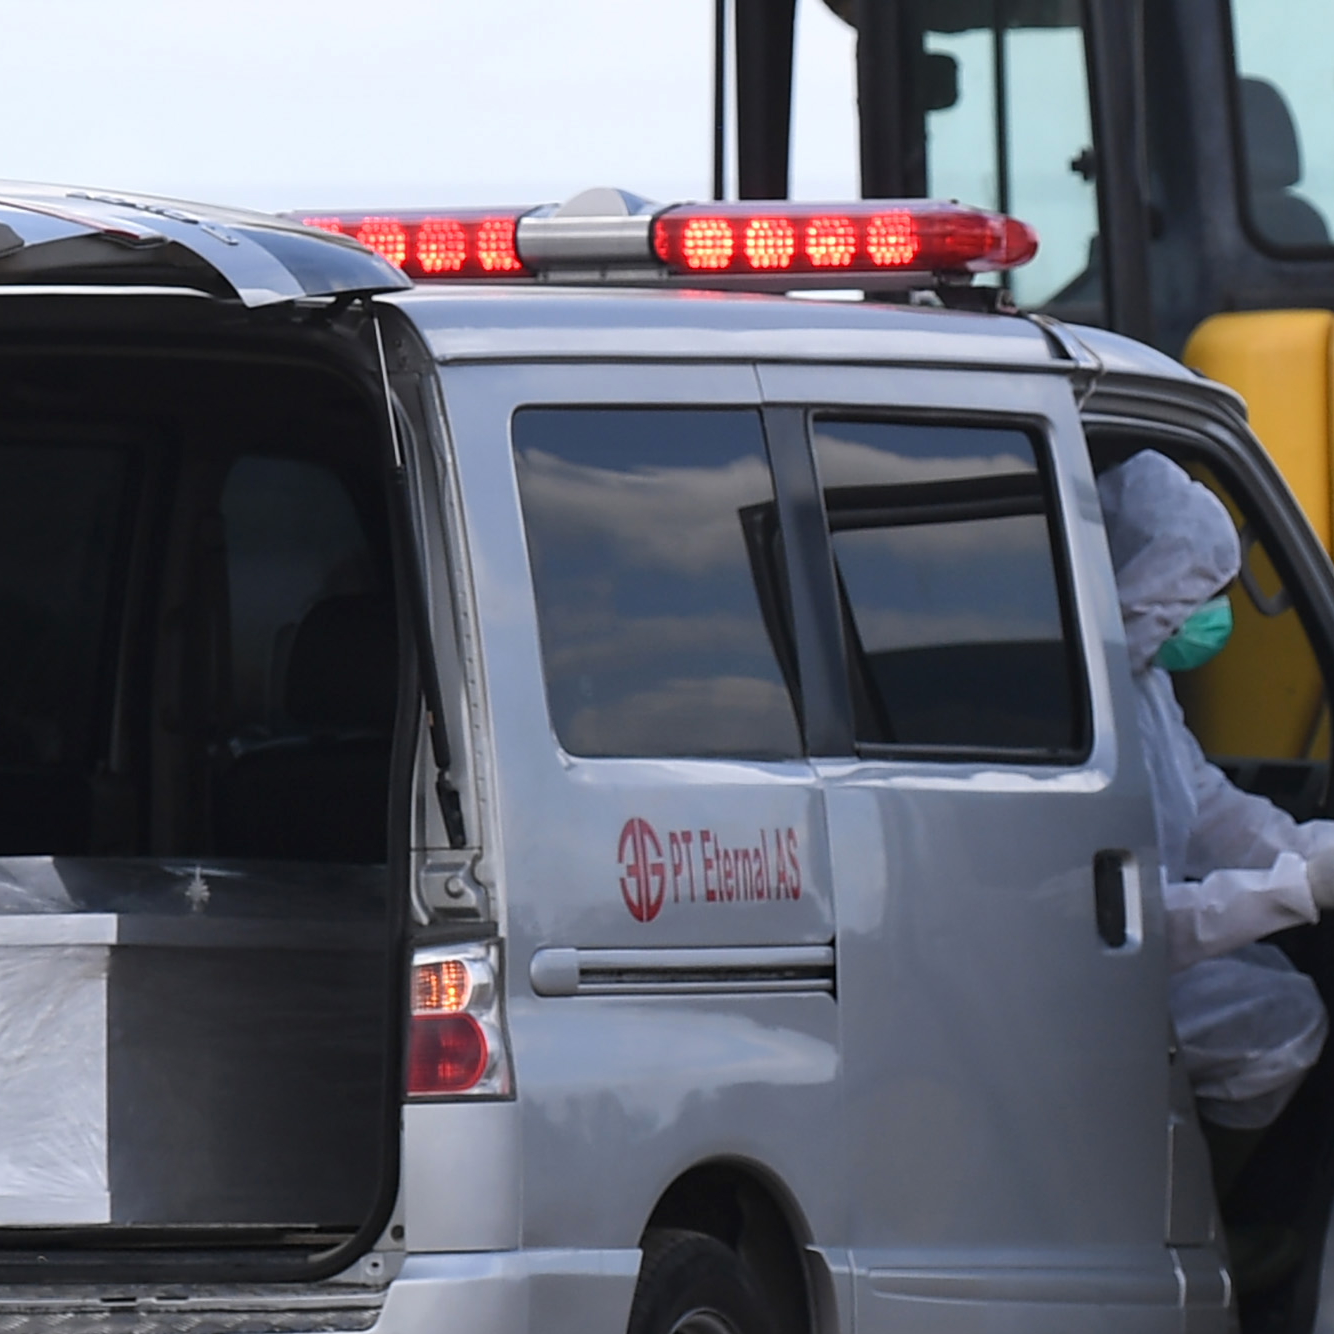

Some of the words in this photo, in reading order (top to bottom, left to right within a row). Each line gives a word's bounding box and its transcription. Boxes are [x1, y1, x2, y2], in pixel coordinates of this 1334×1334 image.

[669, 830, 696, 903] PT
[700, 829, 771, 903] Eternal
[774, 827, 802, 901] AS
